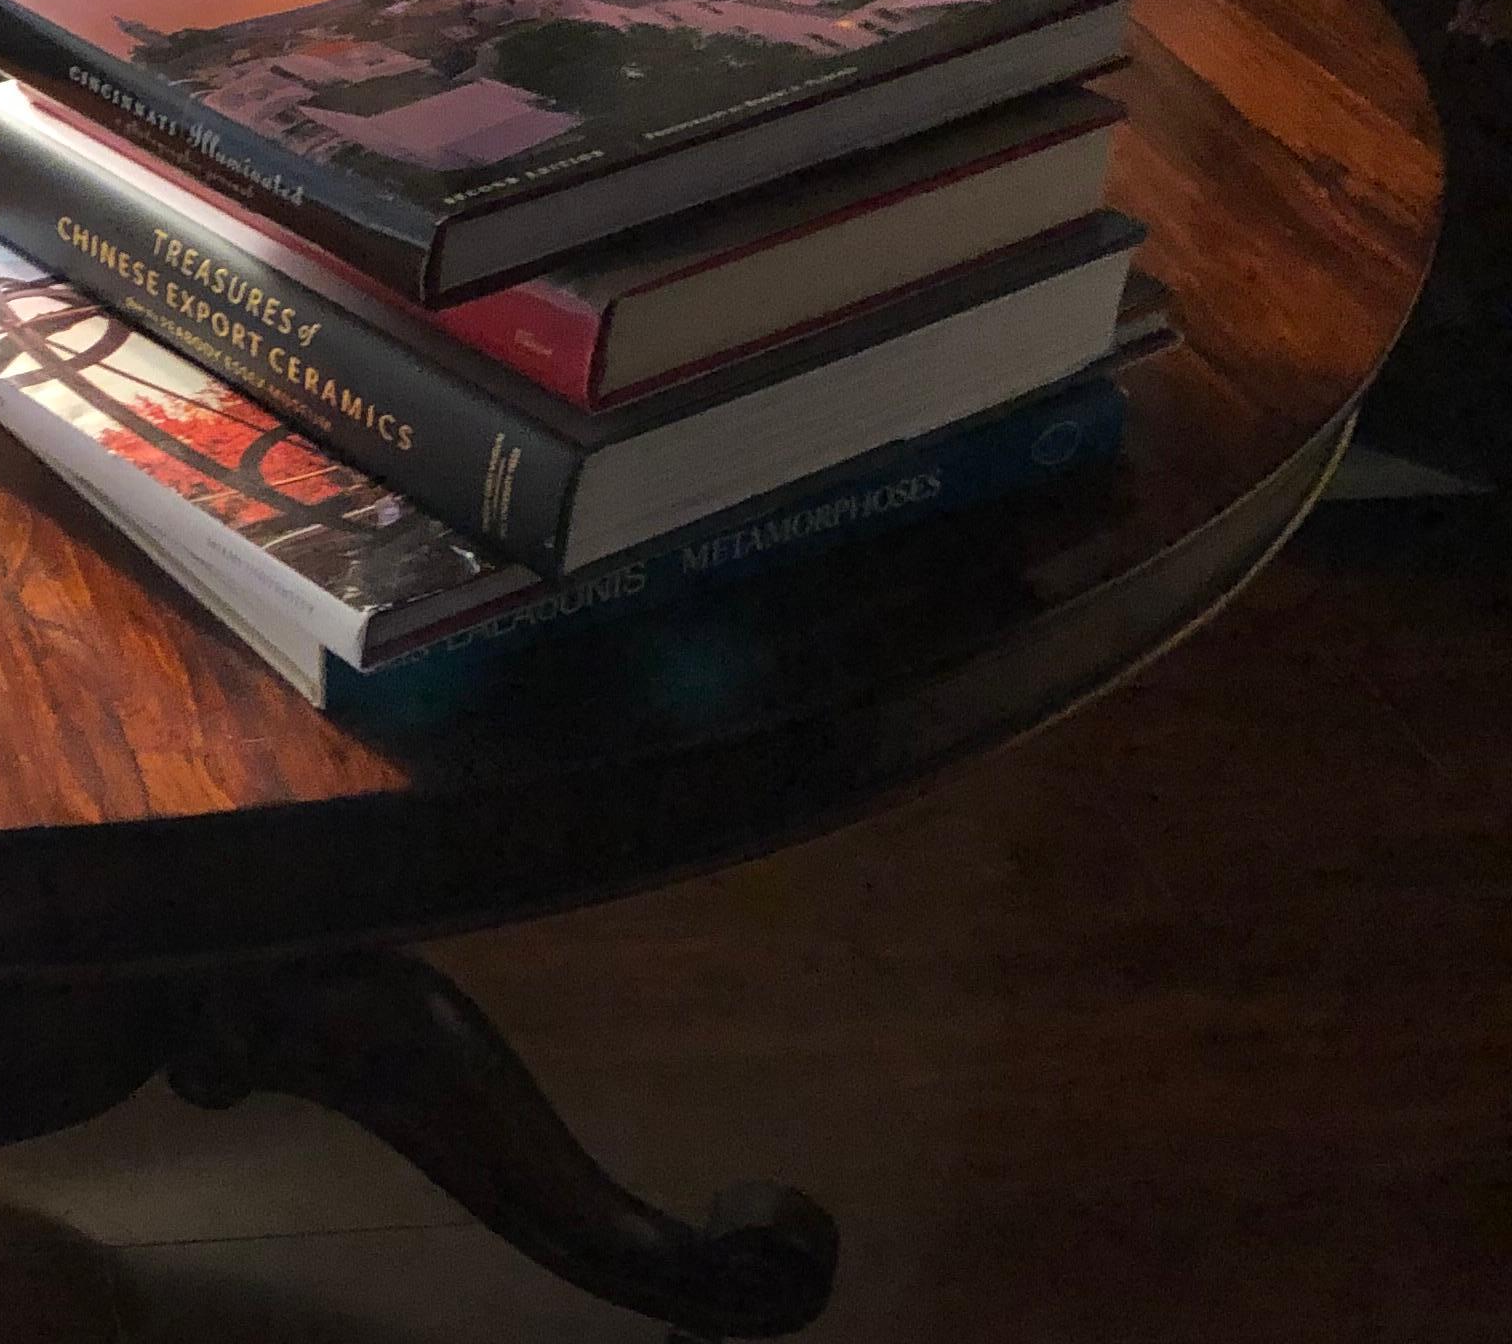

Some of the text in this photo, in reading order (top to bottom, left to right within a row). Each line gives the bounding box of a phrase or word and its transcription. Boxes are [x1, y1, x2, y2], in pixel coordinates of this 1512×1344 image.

[69, 65, 177, 137] CINCINNATI
[57, 216, 415, 451] CHINESE EXPORT CERAMICS
[151, 228, 322, 347] TREASURES of
[681, 472, 943, 572] METAMORPHOSES
